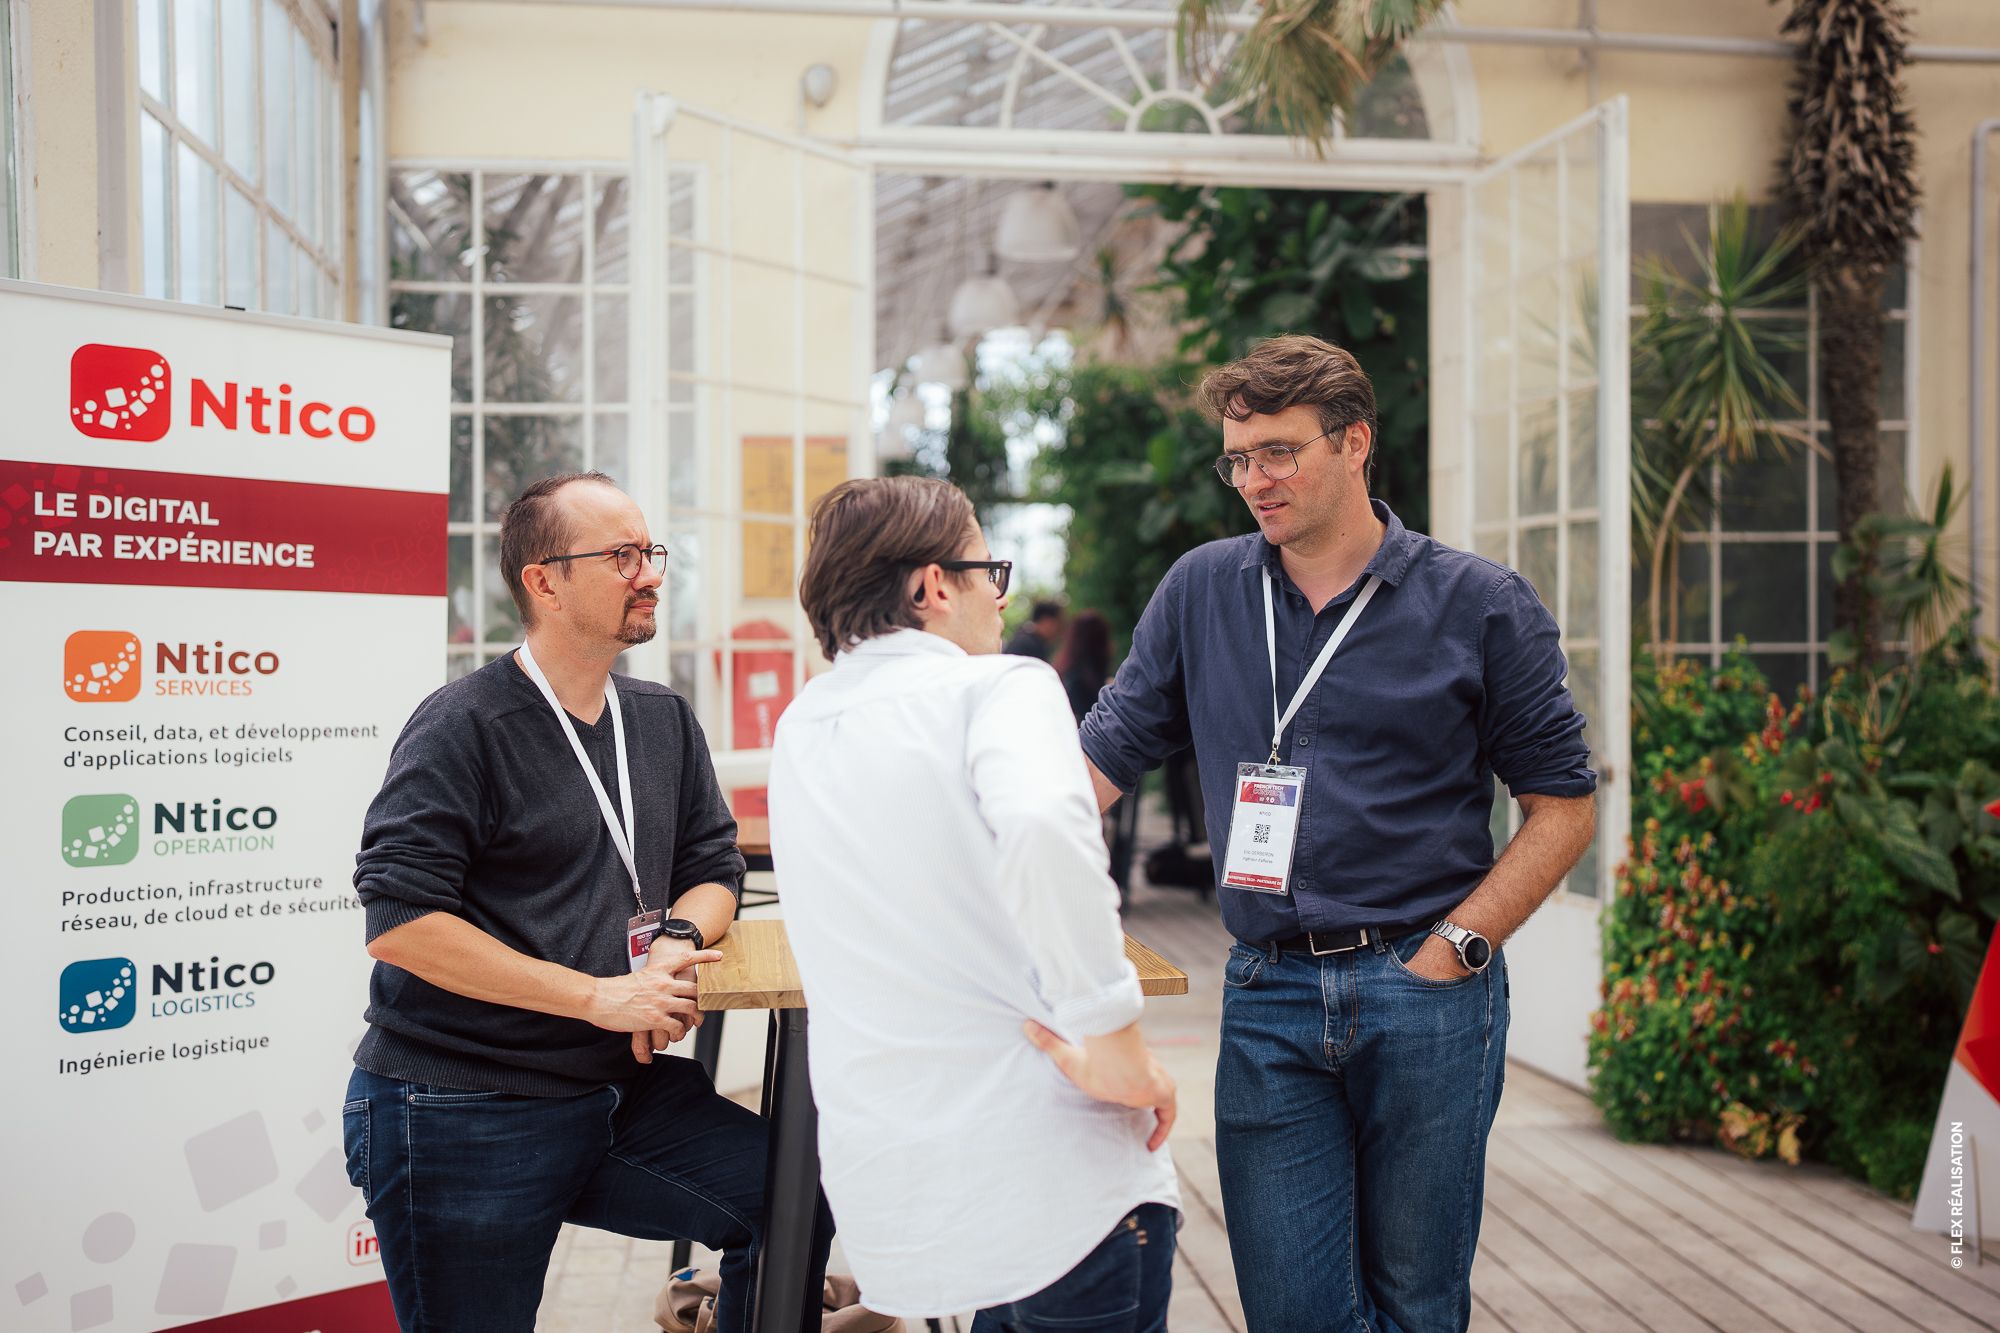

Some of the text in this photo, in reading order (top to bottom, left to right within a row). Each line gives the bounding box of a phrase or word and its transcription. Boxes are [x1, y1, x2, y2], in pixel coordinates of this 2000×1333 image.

[191, 378, 375, 442] Ntico
[35, 492, 219, 525] LE DIGITAL
[35, 531, 314, 567] PAR EXPÉRIENCE
[156, 641, 279, 675] Ntico
[156, 679, 252, 696] SERVICES
[65, 724, 378, 743] Conseil, data, et développement
[64, 748, 292, 770] d'applications logiciels
[155, 798, 278, 834] Ntico
[154, 835, 275, 857] OPERATION
[63, 878, 322, 906] Production, infrastructure
[62, 895, 360, 932] réseau, de cloud et de sécurité
[152, 956, 275, 996] Ntico
[152, 991, 256, 1017] LOGISTICS
[60, 1036, 269, 1075] Ingénierie logistique
[356, 1231, 379, 1256] in
